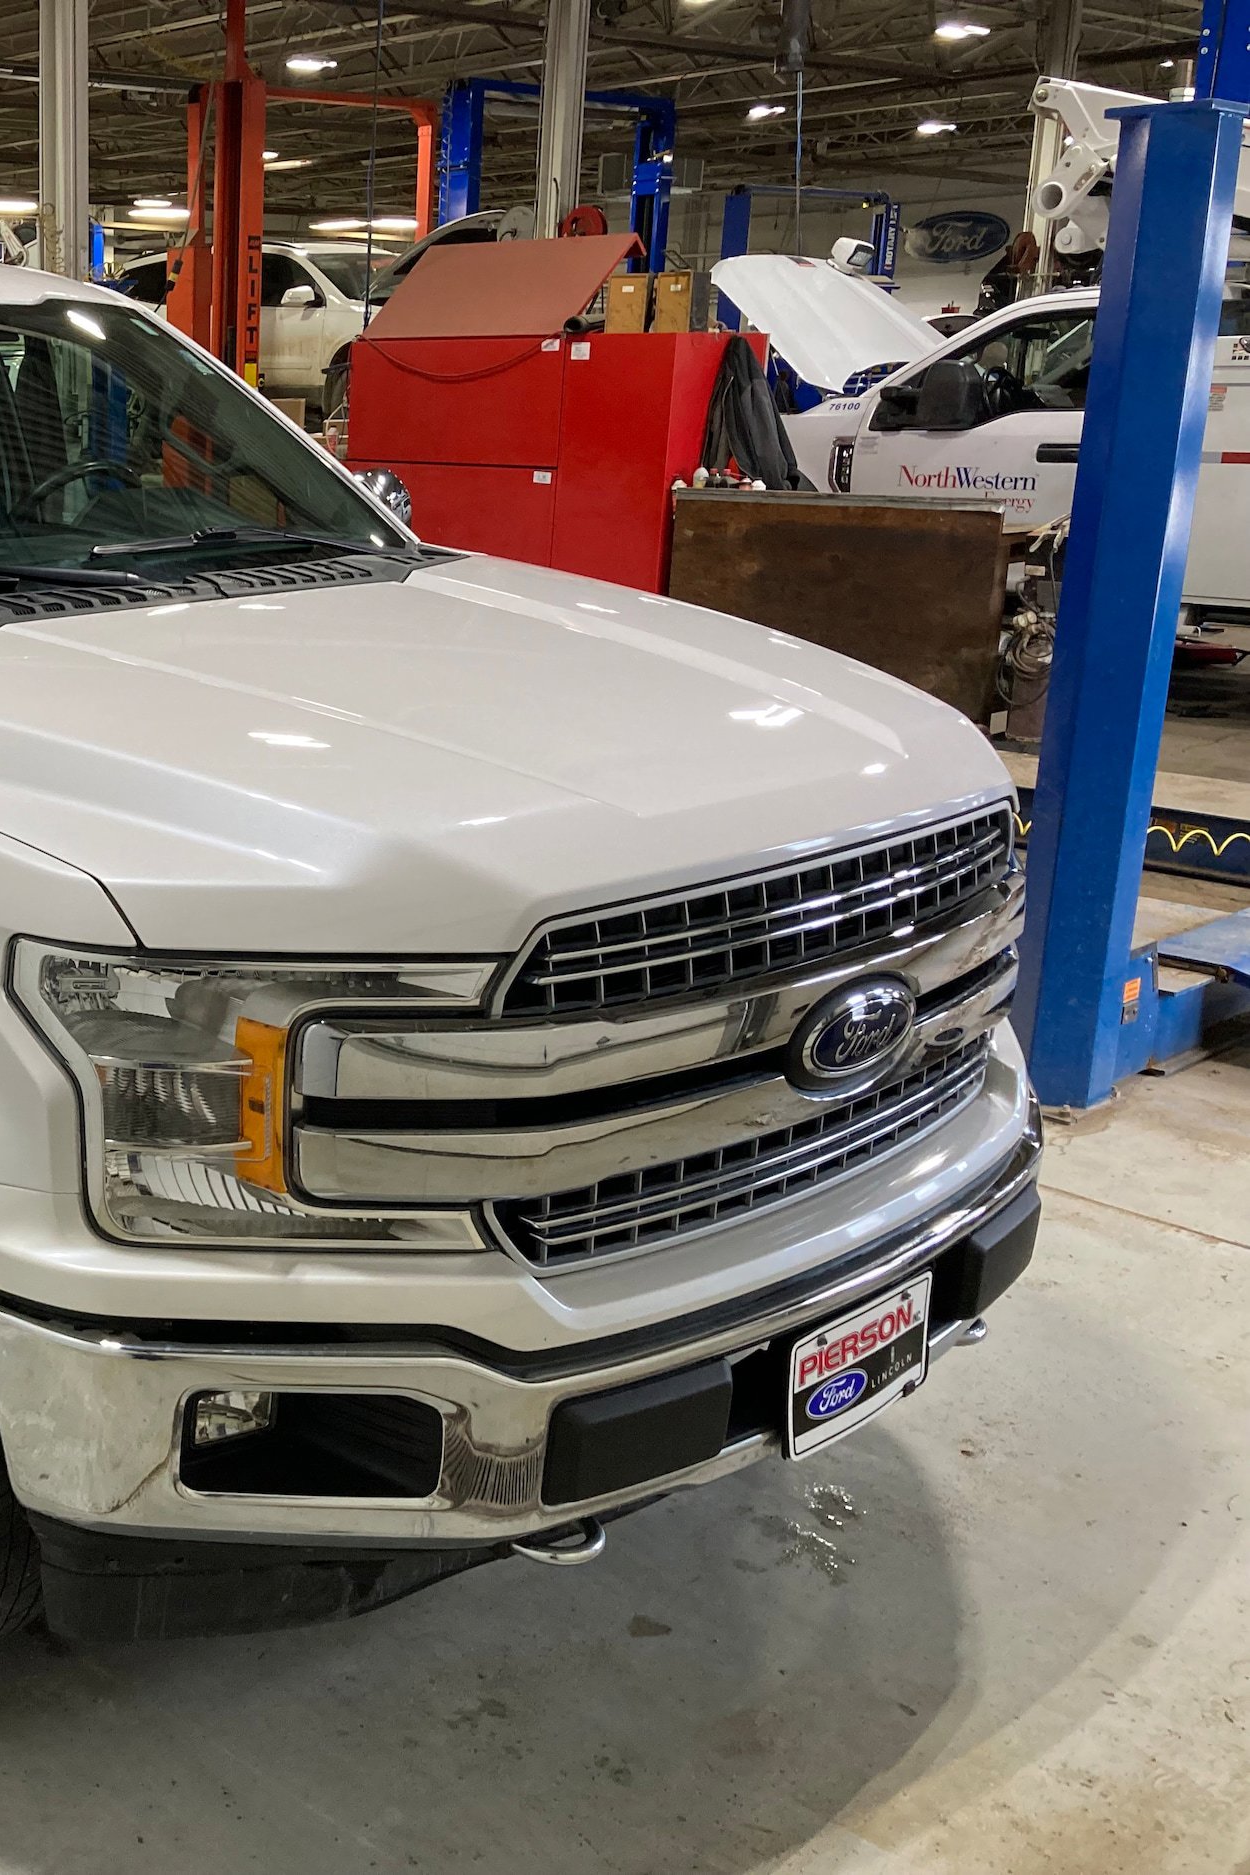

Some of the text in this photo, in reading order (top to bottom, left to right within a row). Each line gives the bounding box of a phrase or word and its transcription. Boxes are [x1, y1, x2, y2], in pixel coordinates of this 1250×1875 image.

[926, 220, 989, 255] Ford
[246, 255, 259, 345] LIFT
[829, 402, 861, 411] 76100
[897, 464, 1037, 491] NorthWestern
[984, 491, 1036, 514] Eergy
[835, 1009, 897, 1063] Ford
[798, 1299, 913, 1388] PIERSON
[871, 1353, 912, 1389] LINCOLN
[818, 1378, 856, 1413] Ford
